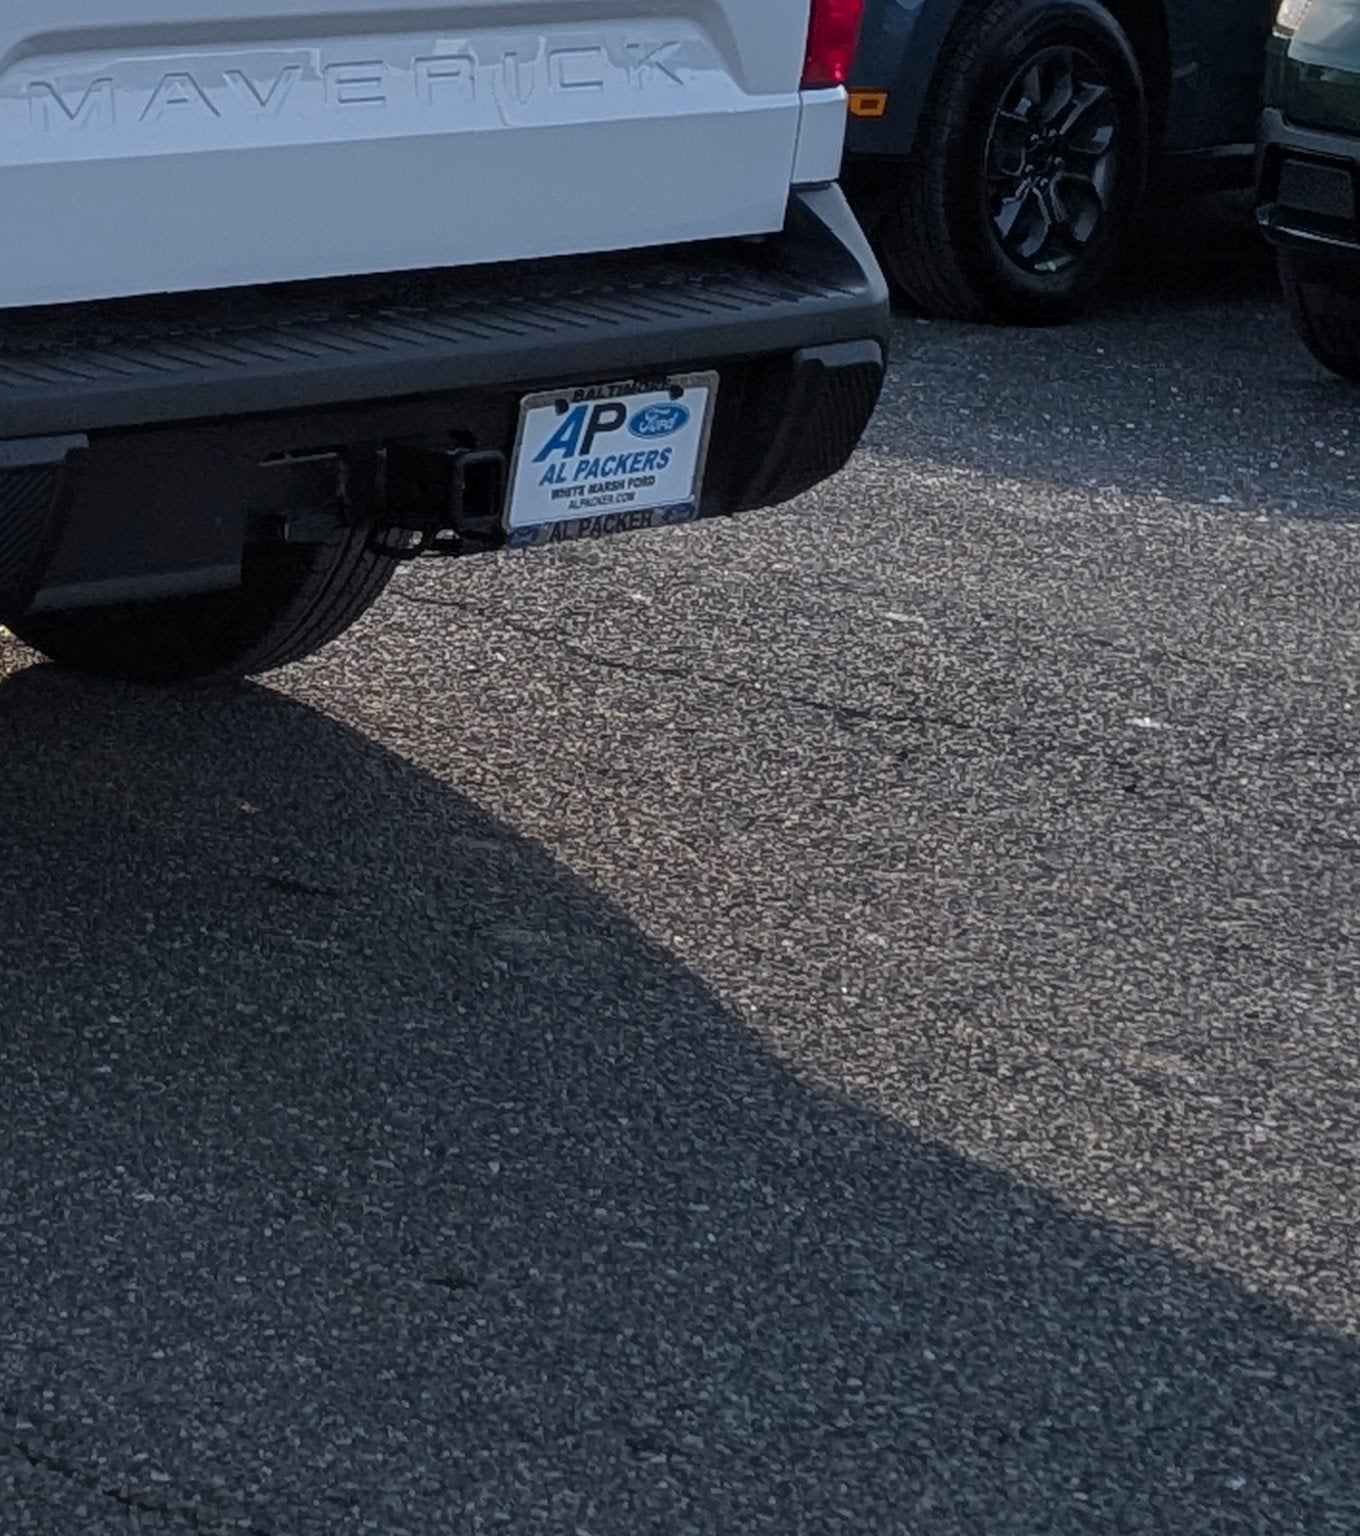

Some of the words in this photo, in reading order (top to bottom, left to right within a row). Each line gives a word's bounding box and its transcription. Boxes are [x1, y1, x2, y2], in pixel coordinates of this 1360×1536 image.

[28, 41, 684, 128] MAVERICK
[533, 402, 627, 463] AP
[639, 407, 678, 434] Ford
[538, 462, 567, 486] AL
[573, 447, 672, 482] PACKERS
[551, 484, 586, 501] WHITE
[587, 479, 626, 495] MARSH
[627, 474, 655, 489] FORD
